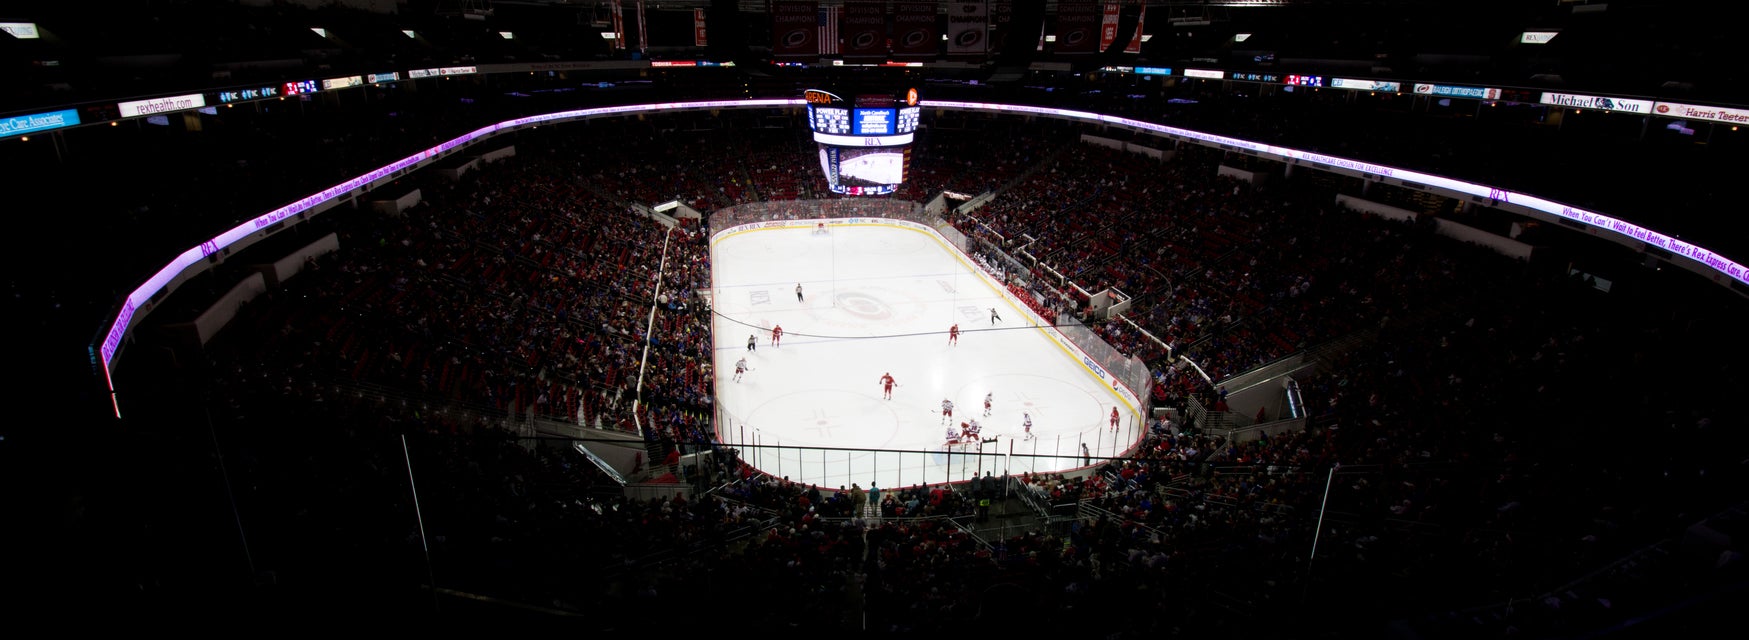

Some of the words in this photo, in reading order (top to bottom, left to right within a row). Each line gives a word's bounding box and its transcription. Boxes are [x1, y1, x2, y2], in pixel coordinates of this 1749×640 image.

[778, 4, 812, 13] DIVISION
[849, 6, 880, 15] DIVISION
[900, 4, 932, 13] DIVISION
[775, 15, 817, 25] CHAMPIONS
[846, 16, 884, 25] CHAMPIONS
[895, 15, 936, 24] CHAMPIONS
[950, 15, 989, 23] CHAMPIONS
[1057, 15, 1096, 24] CHAMPIONS
[1432, 85, 1452, 94] RALEIGH
[136, 97, 192, 115] rexhealth.com
[1550, 93, 1594, 108] Michael
[1616, 100, 1639, 112] Son
[9, 118, 29, 131] Care
[29, 114, 64, 128] Associates
[1685, 107, 1717, 118] Harris
[1717, 111, 1749, 123] Teeter
[1336, 159, 1354, 169] CHOSEN
[1365, 165, 1394, 177] EXCELLENCE
[1489, 187, 1511, 202] REX
[254, 217, 269, 229] When
[268, 214, 277, 222] You
[276, 210, 288, 219] Can't
[200, 238, 220, 257] REX
[1562, 206, 1580, 219] When
[1581, 211, 1593, 222] You
[1593, 215, 1611, 228] Can't
[1613, 220, 1627, 233] Wait
[1627, 225, 1633, 235] to
[1633, 227, 1646, 240] Feel
[1646, 231, 1666, 247] Better,
[1668, 239, 1691, 256] There's
[1692, 247, 1706, 261] Rex
[1705, 252, 1728, 271] Express
[1727, 262, 1742, 278] Care.
[1083, 356, 1105, 379] GEICO
